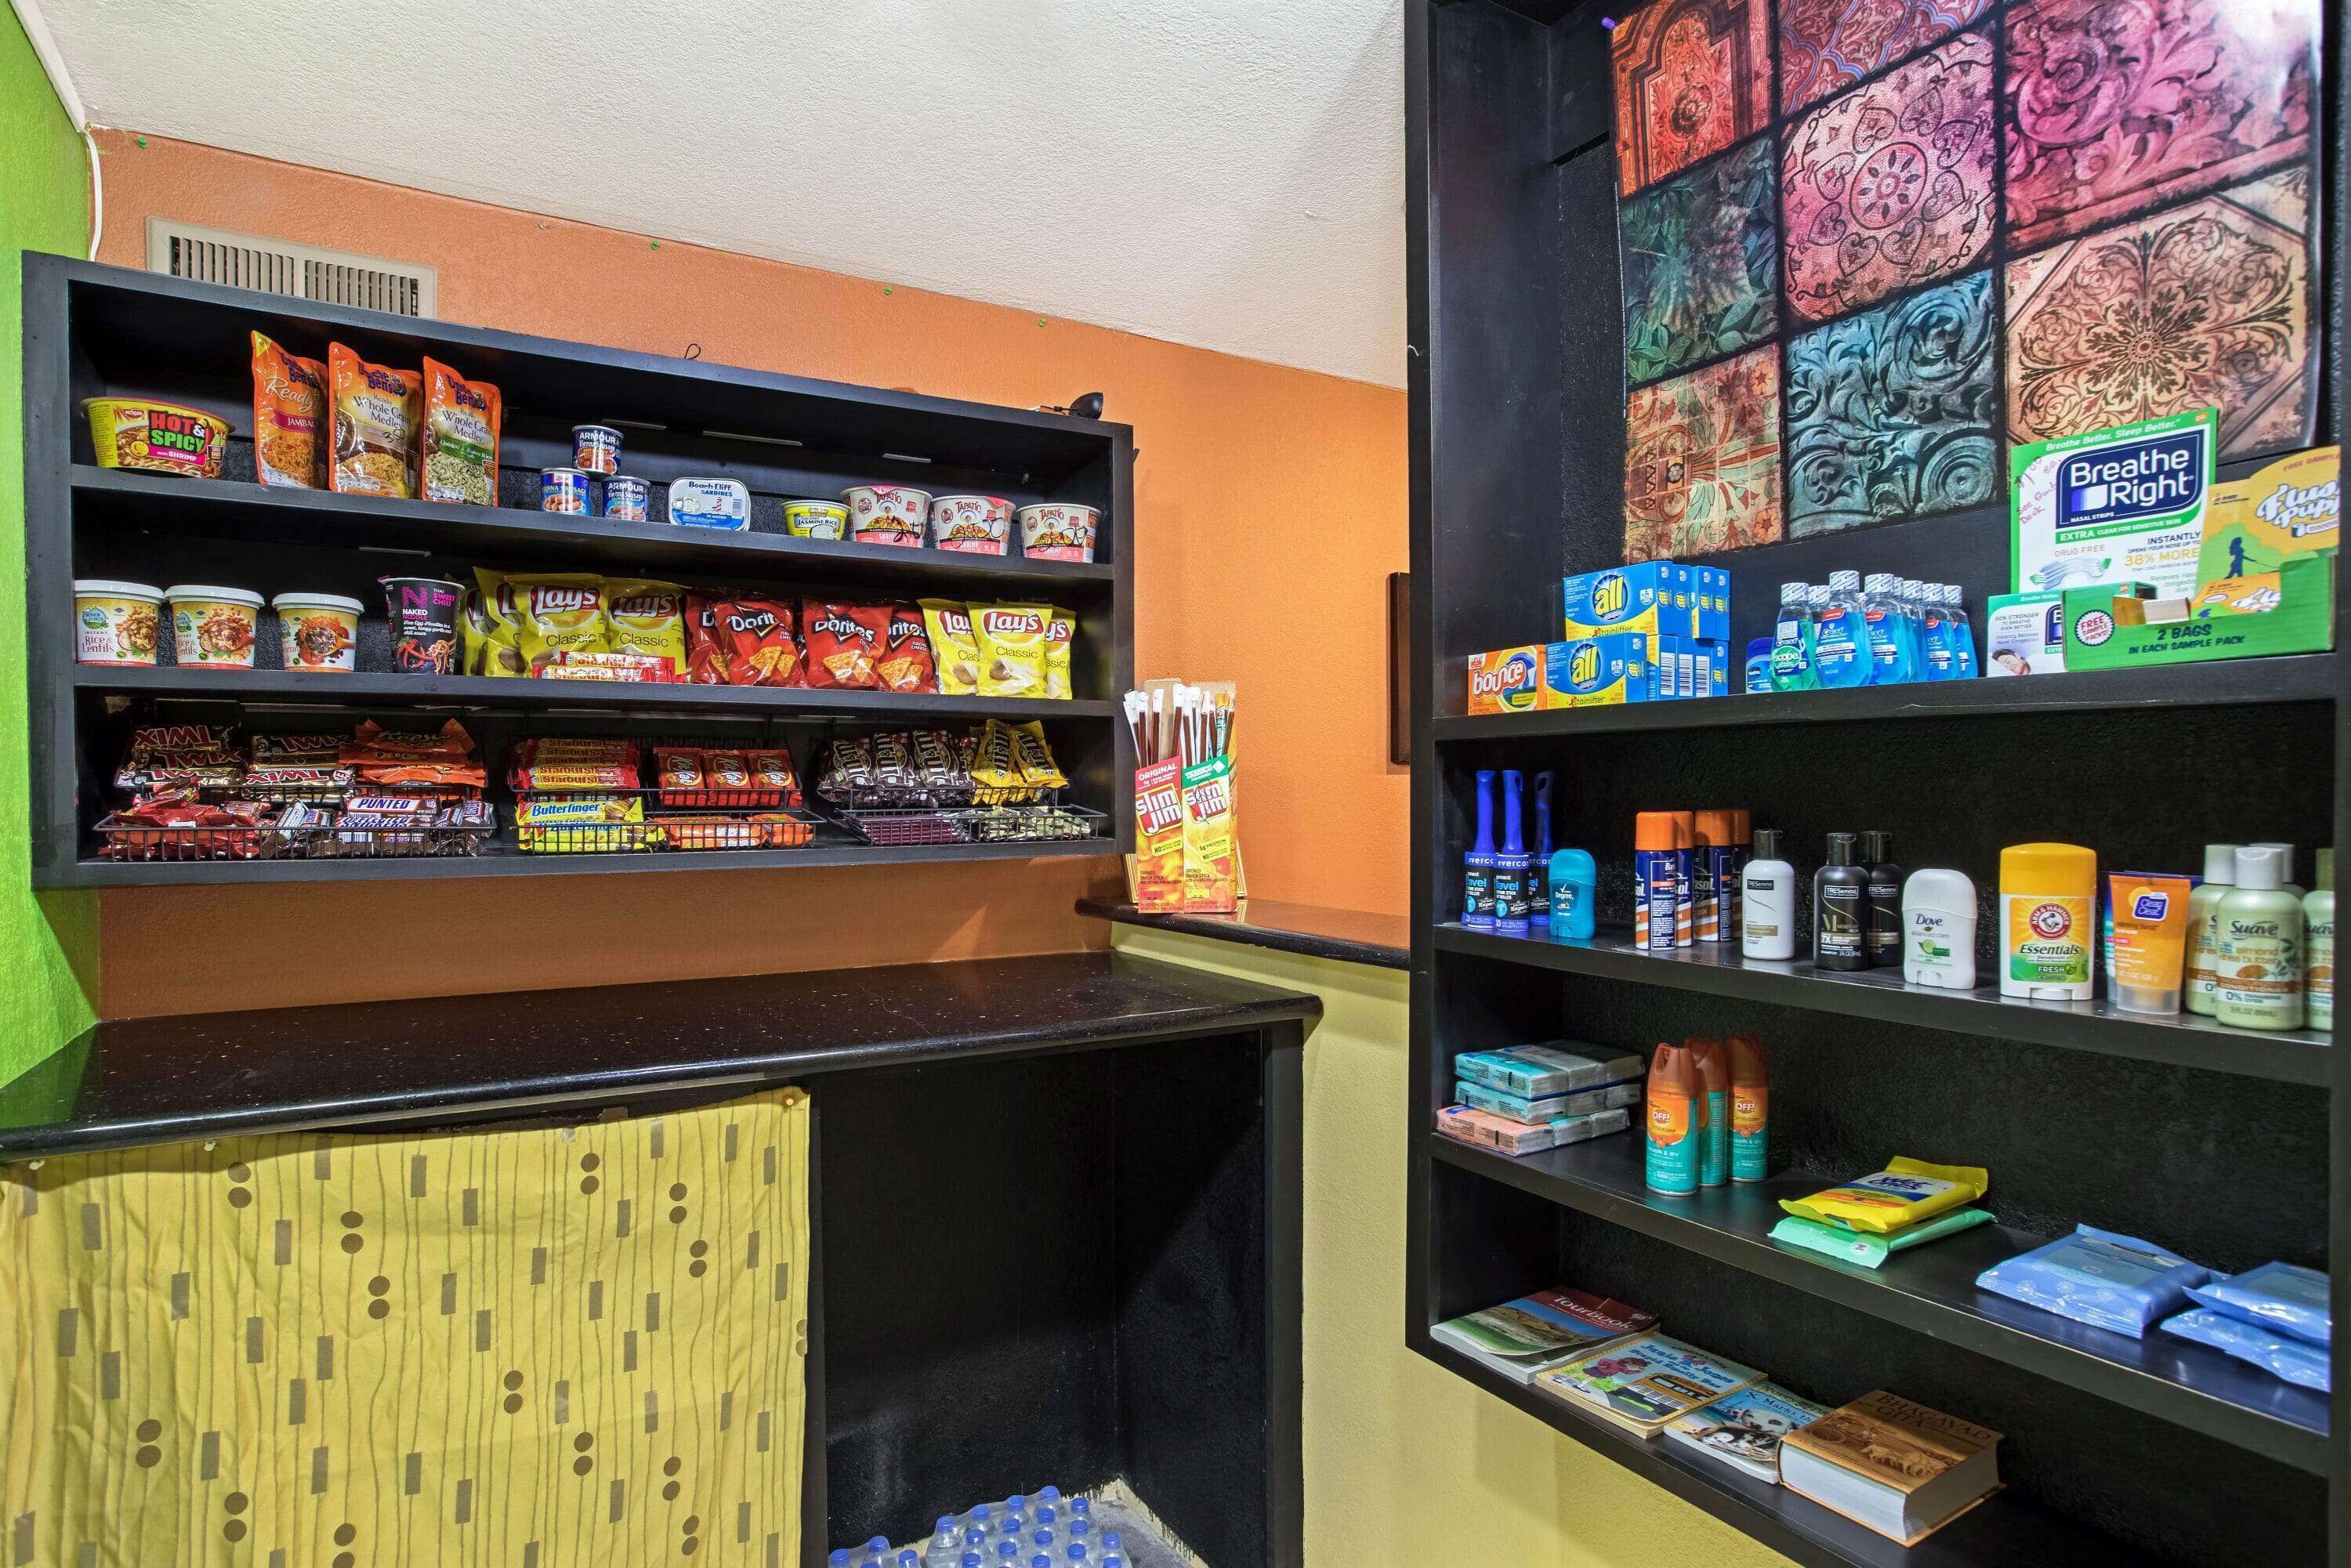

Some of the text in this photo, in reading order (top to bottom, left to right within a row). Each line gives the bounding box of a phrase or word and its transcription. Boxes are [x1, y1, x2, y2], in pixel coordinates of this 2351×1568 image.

[265, 376, 313, 412] Ready
[353, 395, 389, 415] Whole
[150, 411, 205, 438] HOT &
[370, 410, 404, 430] Medley
[150, 429, 205, 452] SPICY
[453, 425, 483, 442] Medley
[579, 432, 617, 444] ARMOUR
[2045, 438, 2081, 452] Breathe
[2083, 433, 2113, 445] Better.
[2114, 427, 2143, 439] Sleep
[168, 451, 197, 462] SHRIMP
[2070, 448, 2192, 488] Breathe
[2283, 460, 2305, 472] FREE
[607, 483, 644, 493] ARMOUR
[688, 480, 714, 490] Beach
[2110, 470, 2190, 508] Right
[701, 489, 734, 498] SARDINES
[2070, 512, 2116, 523] NASAL STRIPS
[2060, 530, 2095, 541] EXTRA
[2096, 527, 2117, 536] CLEAR
[2147, 531, 2201, 545] INSTANTLY
[2054, 543, 2106, 558] DRUG FREE
[2124, 547, 2201, 567] 38% MORE
[433, 592, 458, 602] SWEET
[1595, 574, 1625, 616] all
[433, 599, 452, 607] CHILI
[988, 610, 1041, 634] Lay's
[2008, 612, 2039, 621] STRONGER
[2080, 615, 2105, 629] FREE
[814, 619, 876, 643] Doritos
[888, 621, 926, 638] oritos
[2081, 623, 2109, 636] SAMPLE
[2157, 623, 2213, 641] 2 BAGS
[85, 635, 105, 646] Rice
[546, 632, 596, 647] Classic
[619, 632, 669, 648] Classic
[2128, 635, 2246, 655] IN EACH SAMPLE PACK
[82, 643, 115, 654] Lentils
[995, 646, 1038, 660] Classic
[1571, 644, 1599, 685] all
[1774, 652, 1800, 662] scope
[1473, 660, 1525, 696] bounce
[133, 726, 222, 748] TWIX
[156, 752, 242, 769] TWIX
[245, 770, 330, 784] TWIX
[538, 766, 596, 775] Starburst
[1138, 762, 1179, 781] ORIGINAL
[541, 775, 600, 784] Starburst
[1185, 783, 1224, 806] slim
[357, 798, 411, 810] PUNTED
[531, 802, 601, 817] Butterfinger
[1136, 790, 1177, 817] slim
[1196, 798, 1227, 821] jim
[1147, 804, 1182, 834] jim
[1205, 838, 1227, 848] PROTEIN
[1915, 913, 1943, 926] Dove
[2031, 911, 2041, 925] ARM
[2046, 905, 2070, 925] HAMMER
[2230, 921, 2280, 936] Suave
[2019, 943, 2081, 955] Essentials
[2226, 991, 2243, 1002] 0%
[1735, 1102, 1755, 1111] OFF!
[1652, 1111, 1671, 1123] OFF!
[1555, 1294, 1635, 1330] TourBook
[1694, 1365, 1737, 1385] Jones
[1744, 1390, 1761, 1400] X
[1763, 1396, 1797, 1417] Marks
[1875, 1393, 1993, 1442] BHAGAVAD
[1876, 1404, 1926, 1429] GITA
